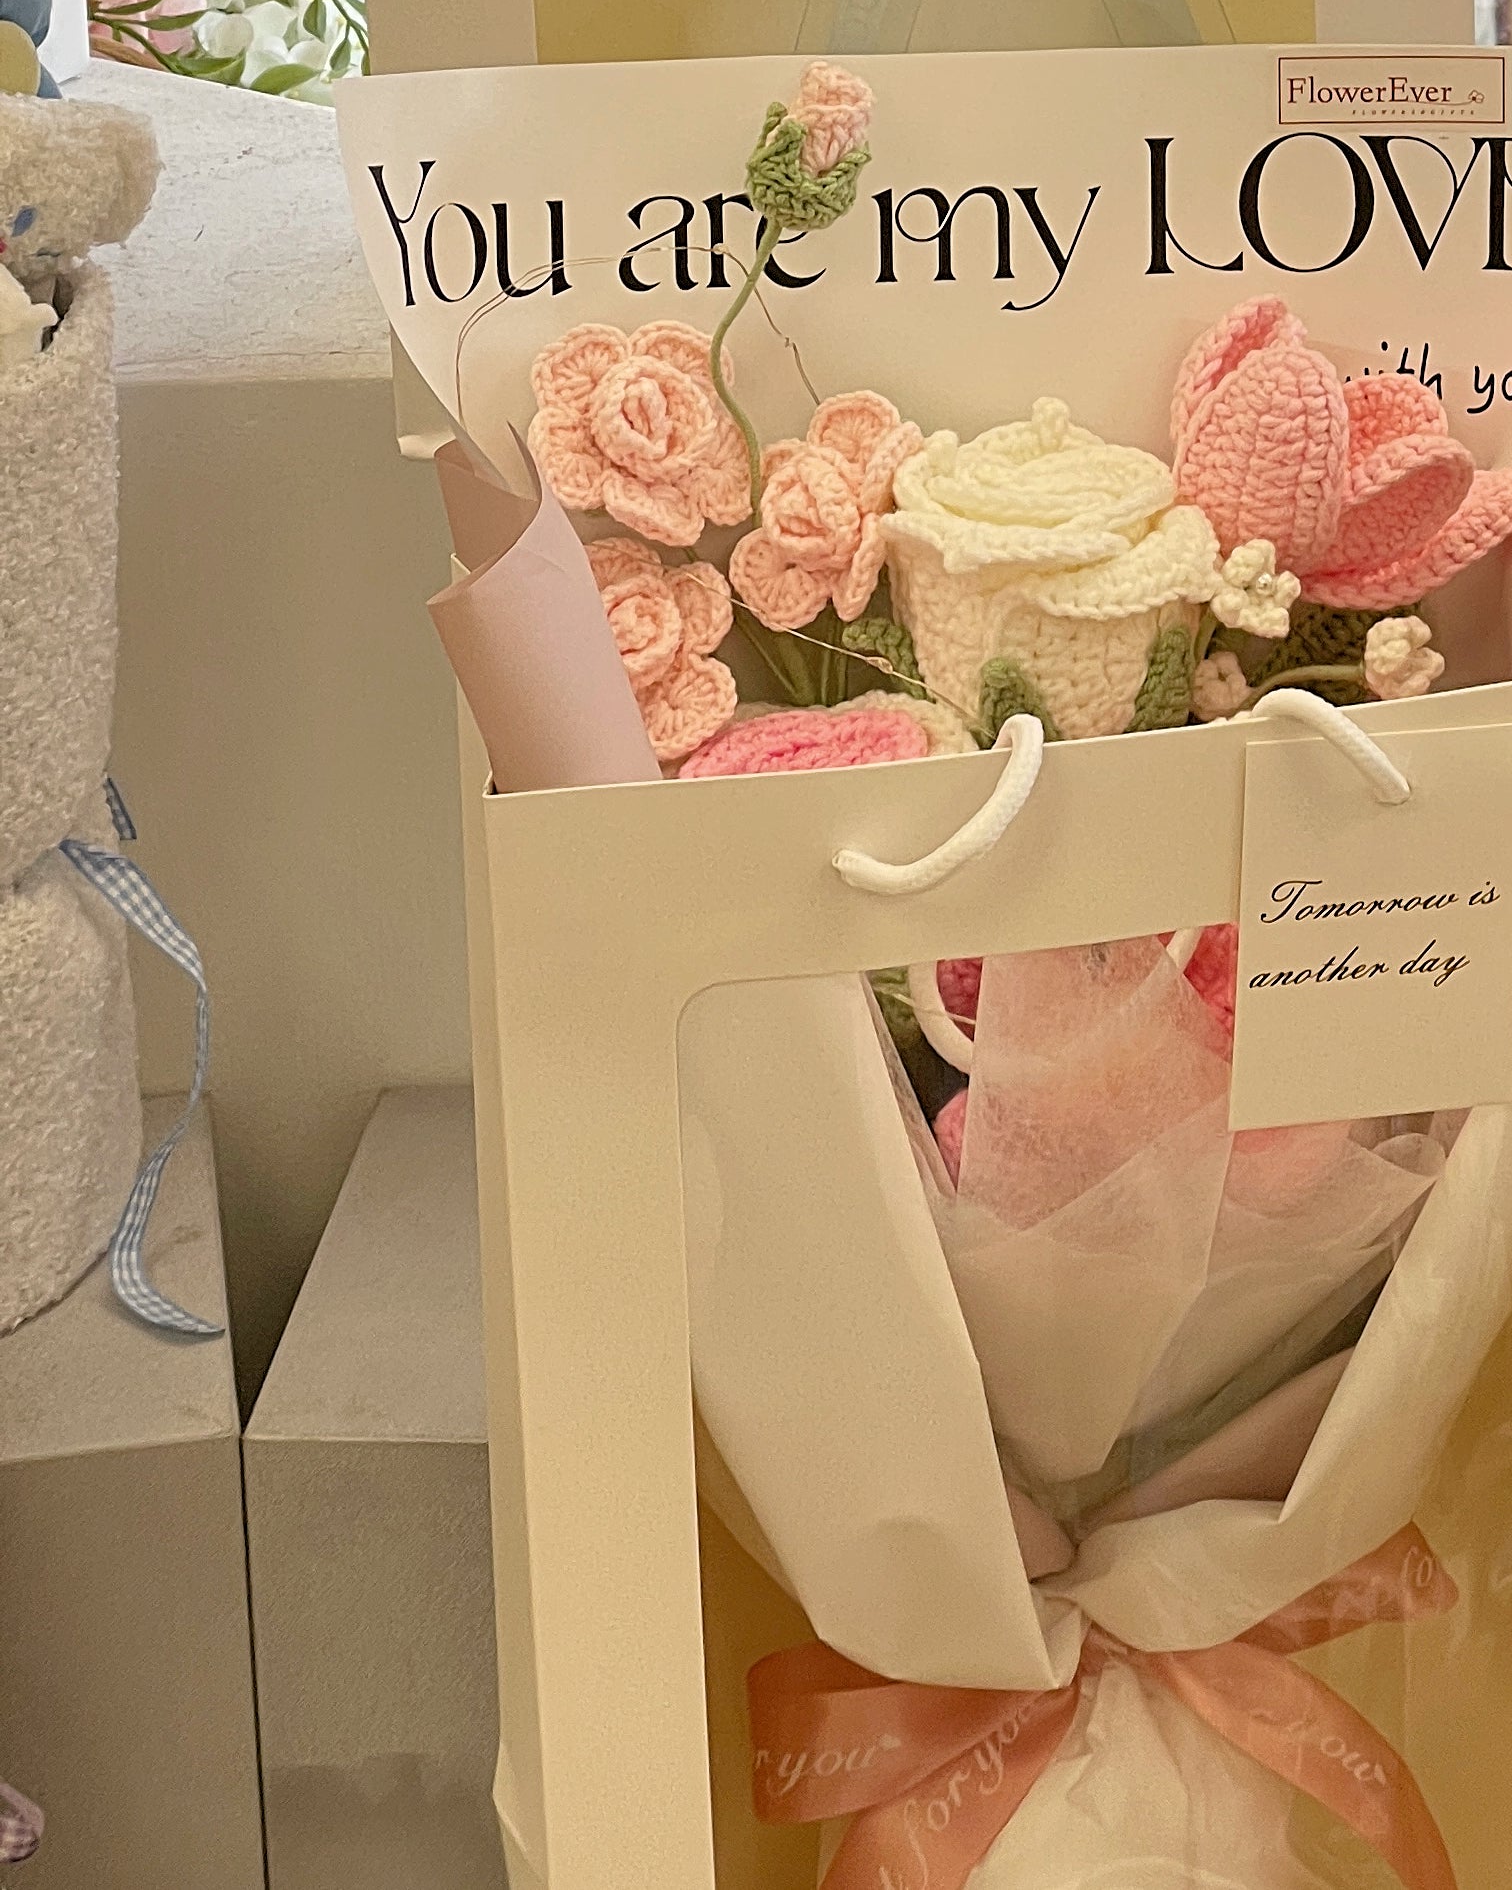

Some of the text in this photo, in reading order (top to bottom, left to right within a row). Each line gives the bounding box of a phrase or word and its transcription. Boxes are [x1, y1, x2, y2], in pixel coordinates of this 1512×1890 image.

[1286, 75, 1453, 104] FlowerEver
[367, 159, 568, 309] You
[873, 184, 1102, 311] my
[1260, 880, 1501, 924] Tomorrow is
[1249, 939, 1471, 989] another day
